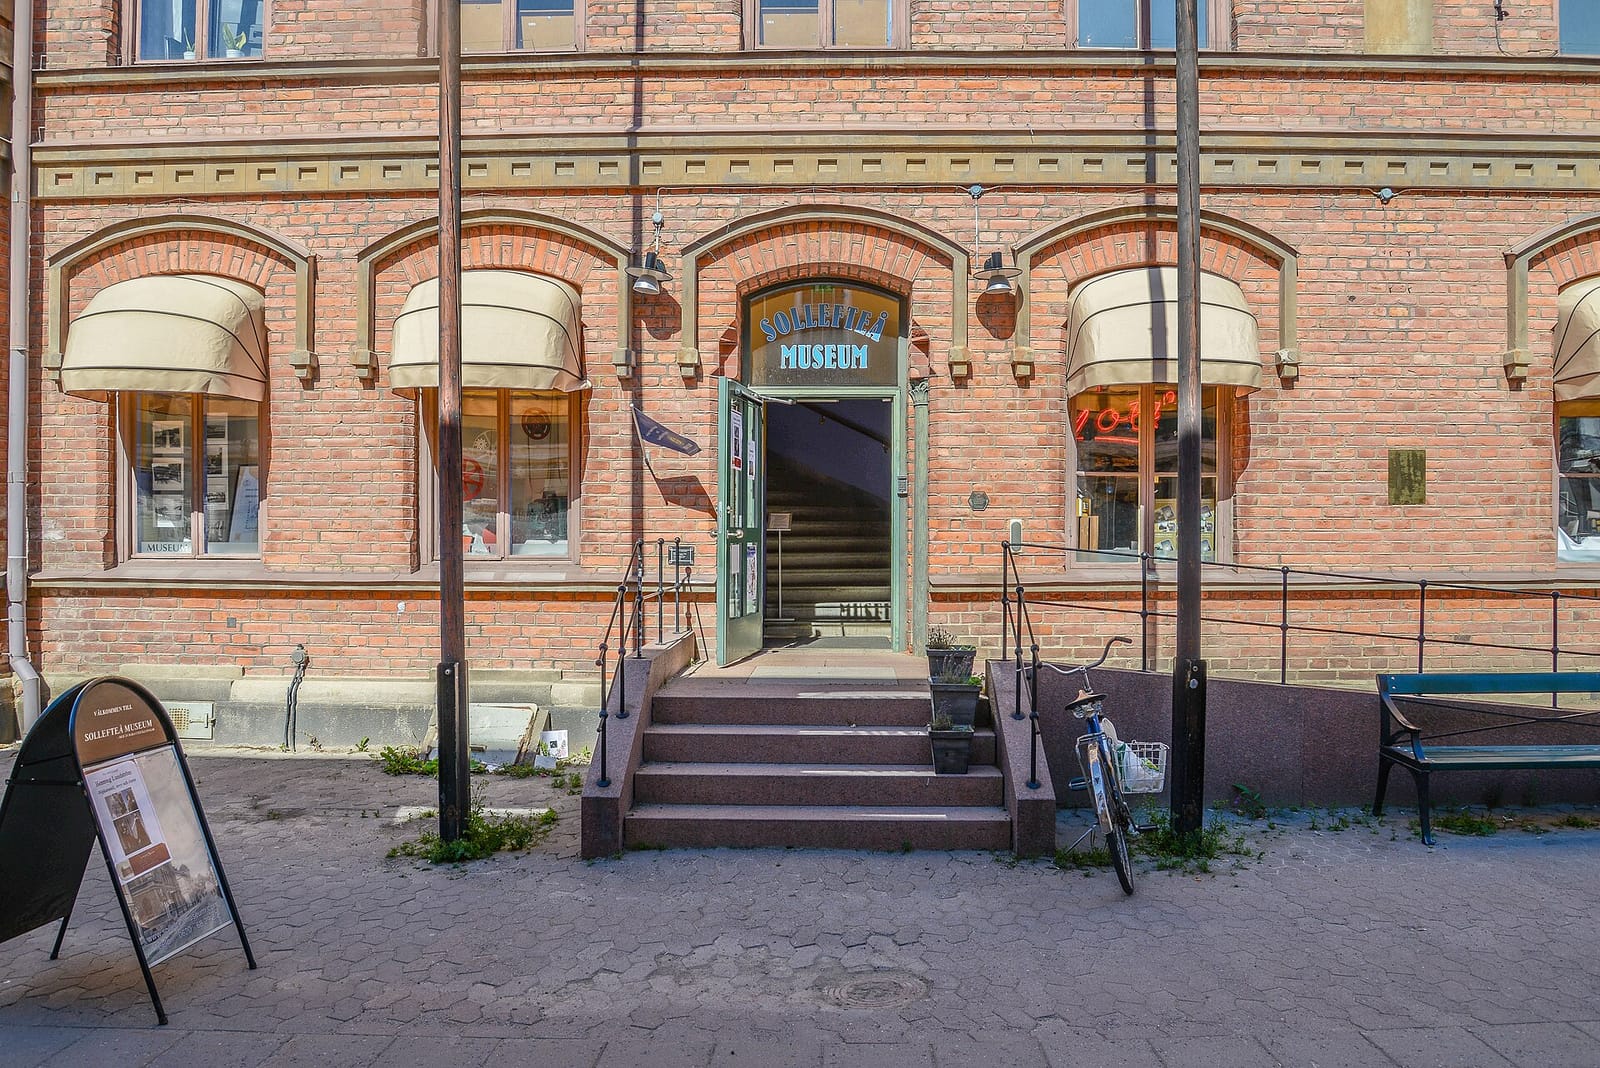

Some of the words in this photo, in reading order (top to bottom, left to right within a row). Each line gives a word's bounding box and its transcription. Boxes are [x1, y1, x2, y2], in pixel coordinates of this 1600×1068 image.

[760, 303, 888, 342] SOLLEFTEÅ
[780, 344, 868, 369] MUSEUM
[84, 725, 123, 741] SOLLEFTEÅ
[124, 720, 152, 732] MUSEUM
